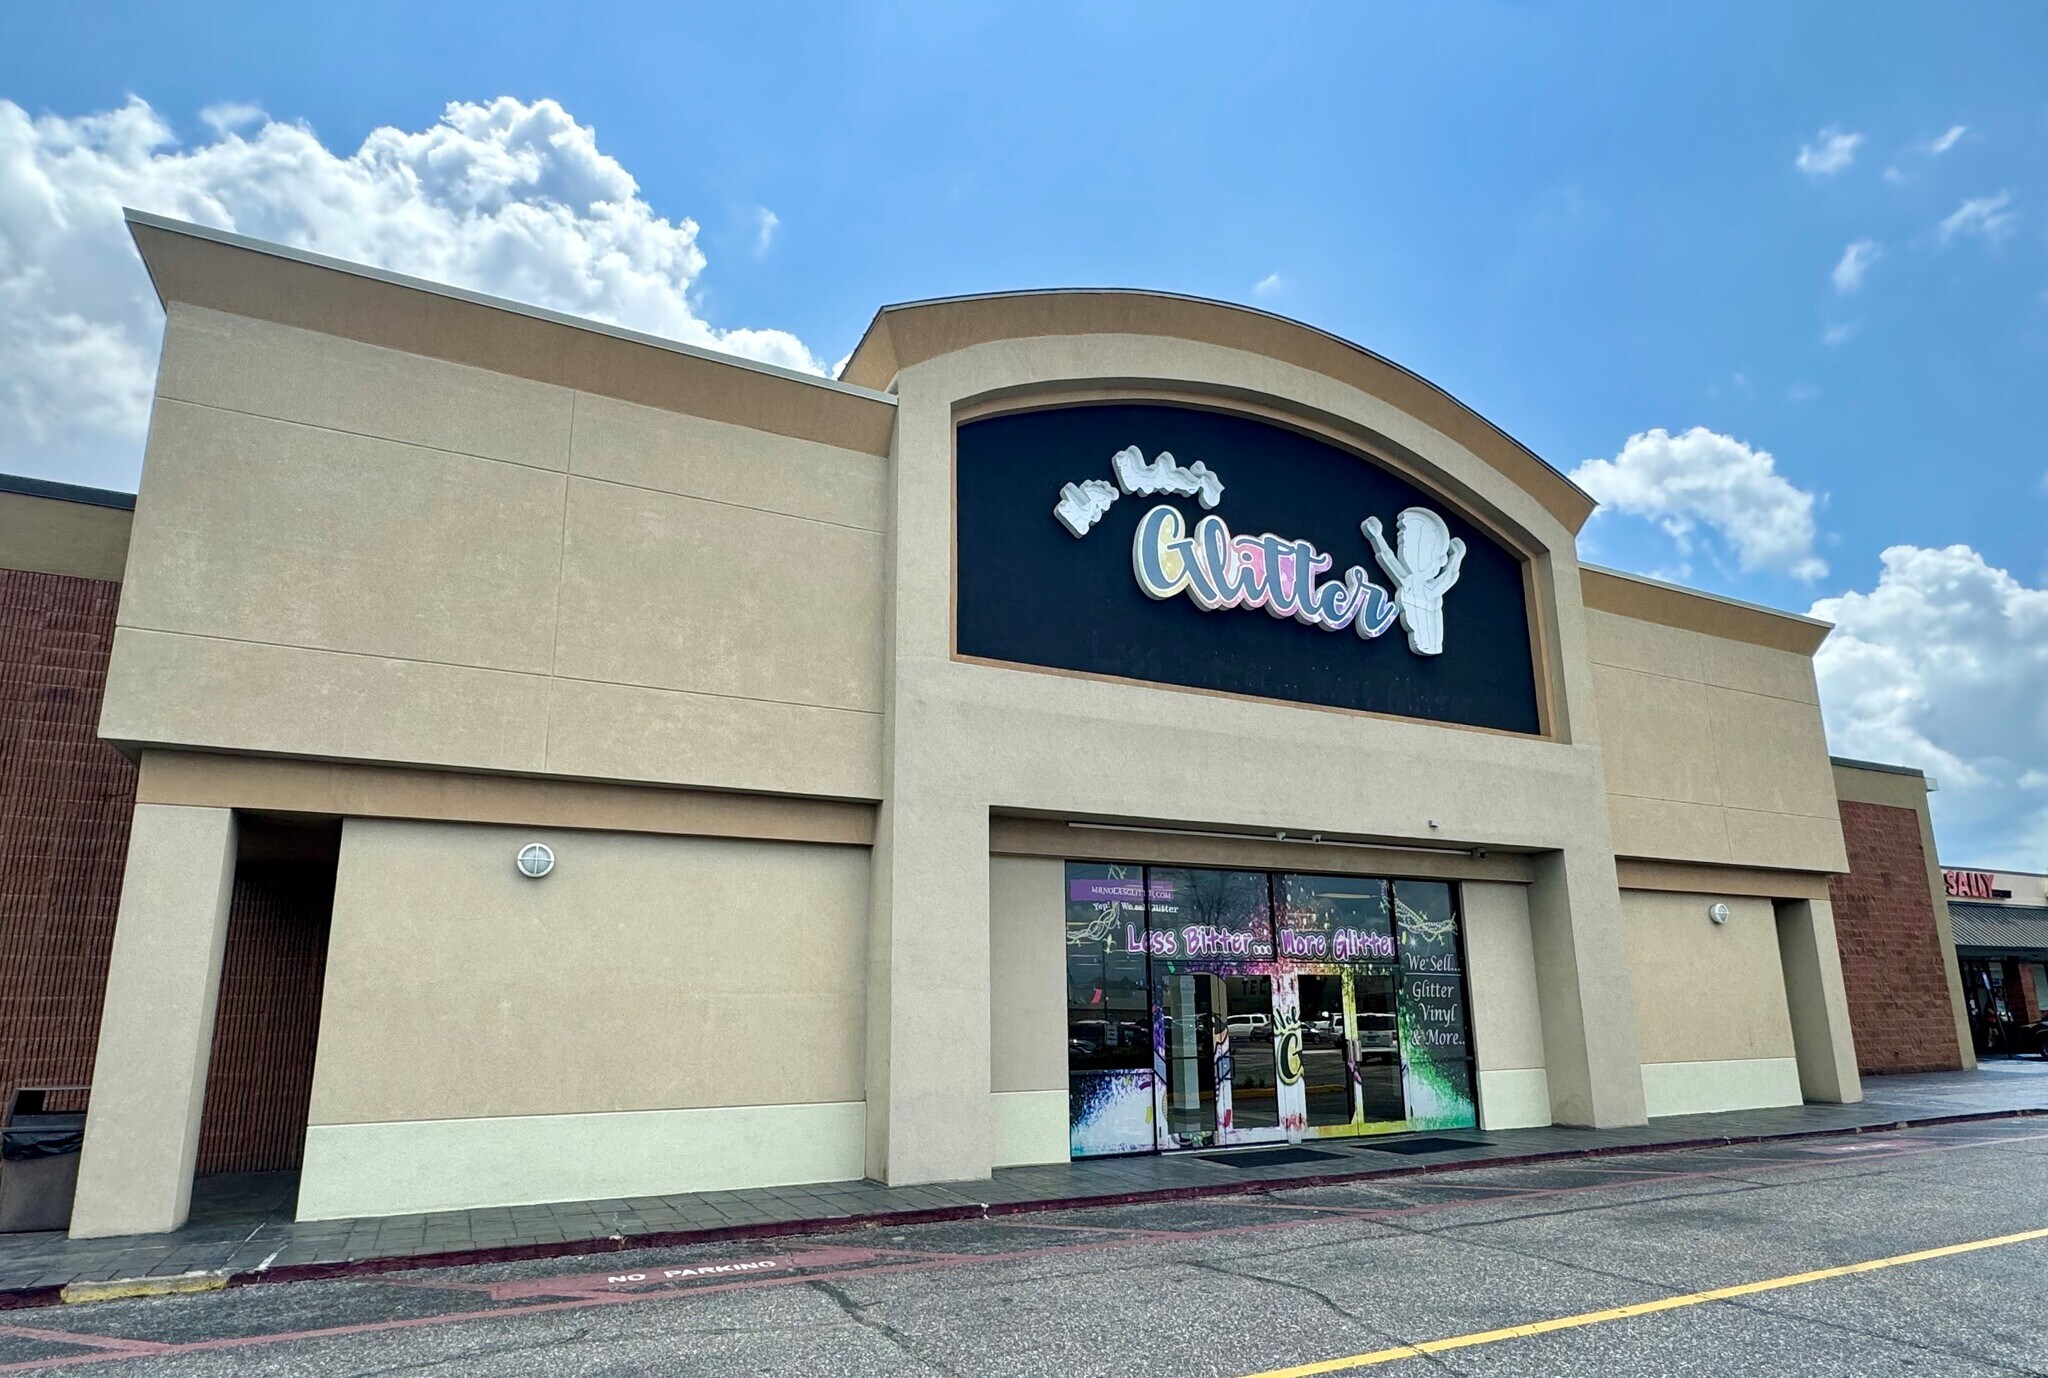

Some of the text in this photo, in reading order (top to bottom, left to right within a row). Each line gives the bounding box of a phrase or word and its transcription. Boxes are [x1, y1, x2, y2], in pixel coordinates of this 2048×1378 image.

[1133, 504, 1398, 639] Glitter
[1091, 886, 1172, 899] MRNOLASGLITTR.COM
[1944, 871, 1994, 898] SALLY
[1126, 923, 1177, 956] Less
[1280, 928, 1326, 957] More
[1333, 928, 1398, 961] Glitter
[1405, 952, 1461, 972] We Sell...
[1412, 979, 1454, 1001] Glitter
[1418, 1002, 1458, 1028] Vinyl
[1411, 1028, 1421, 1046] &
[607, 1260, 776, 1283] NO PARKING
